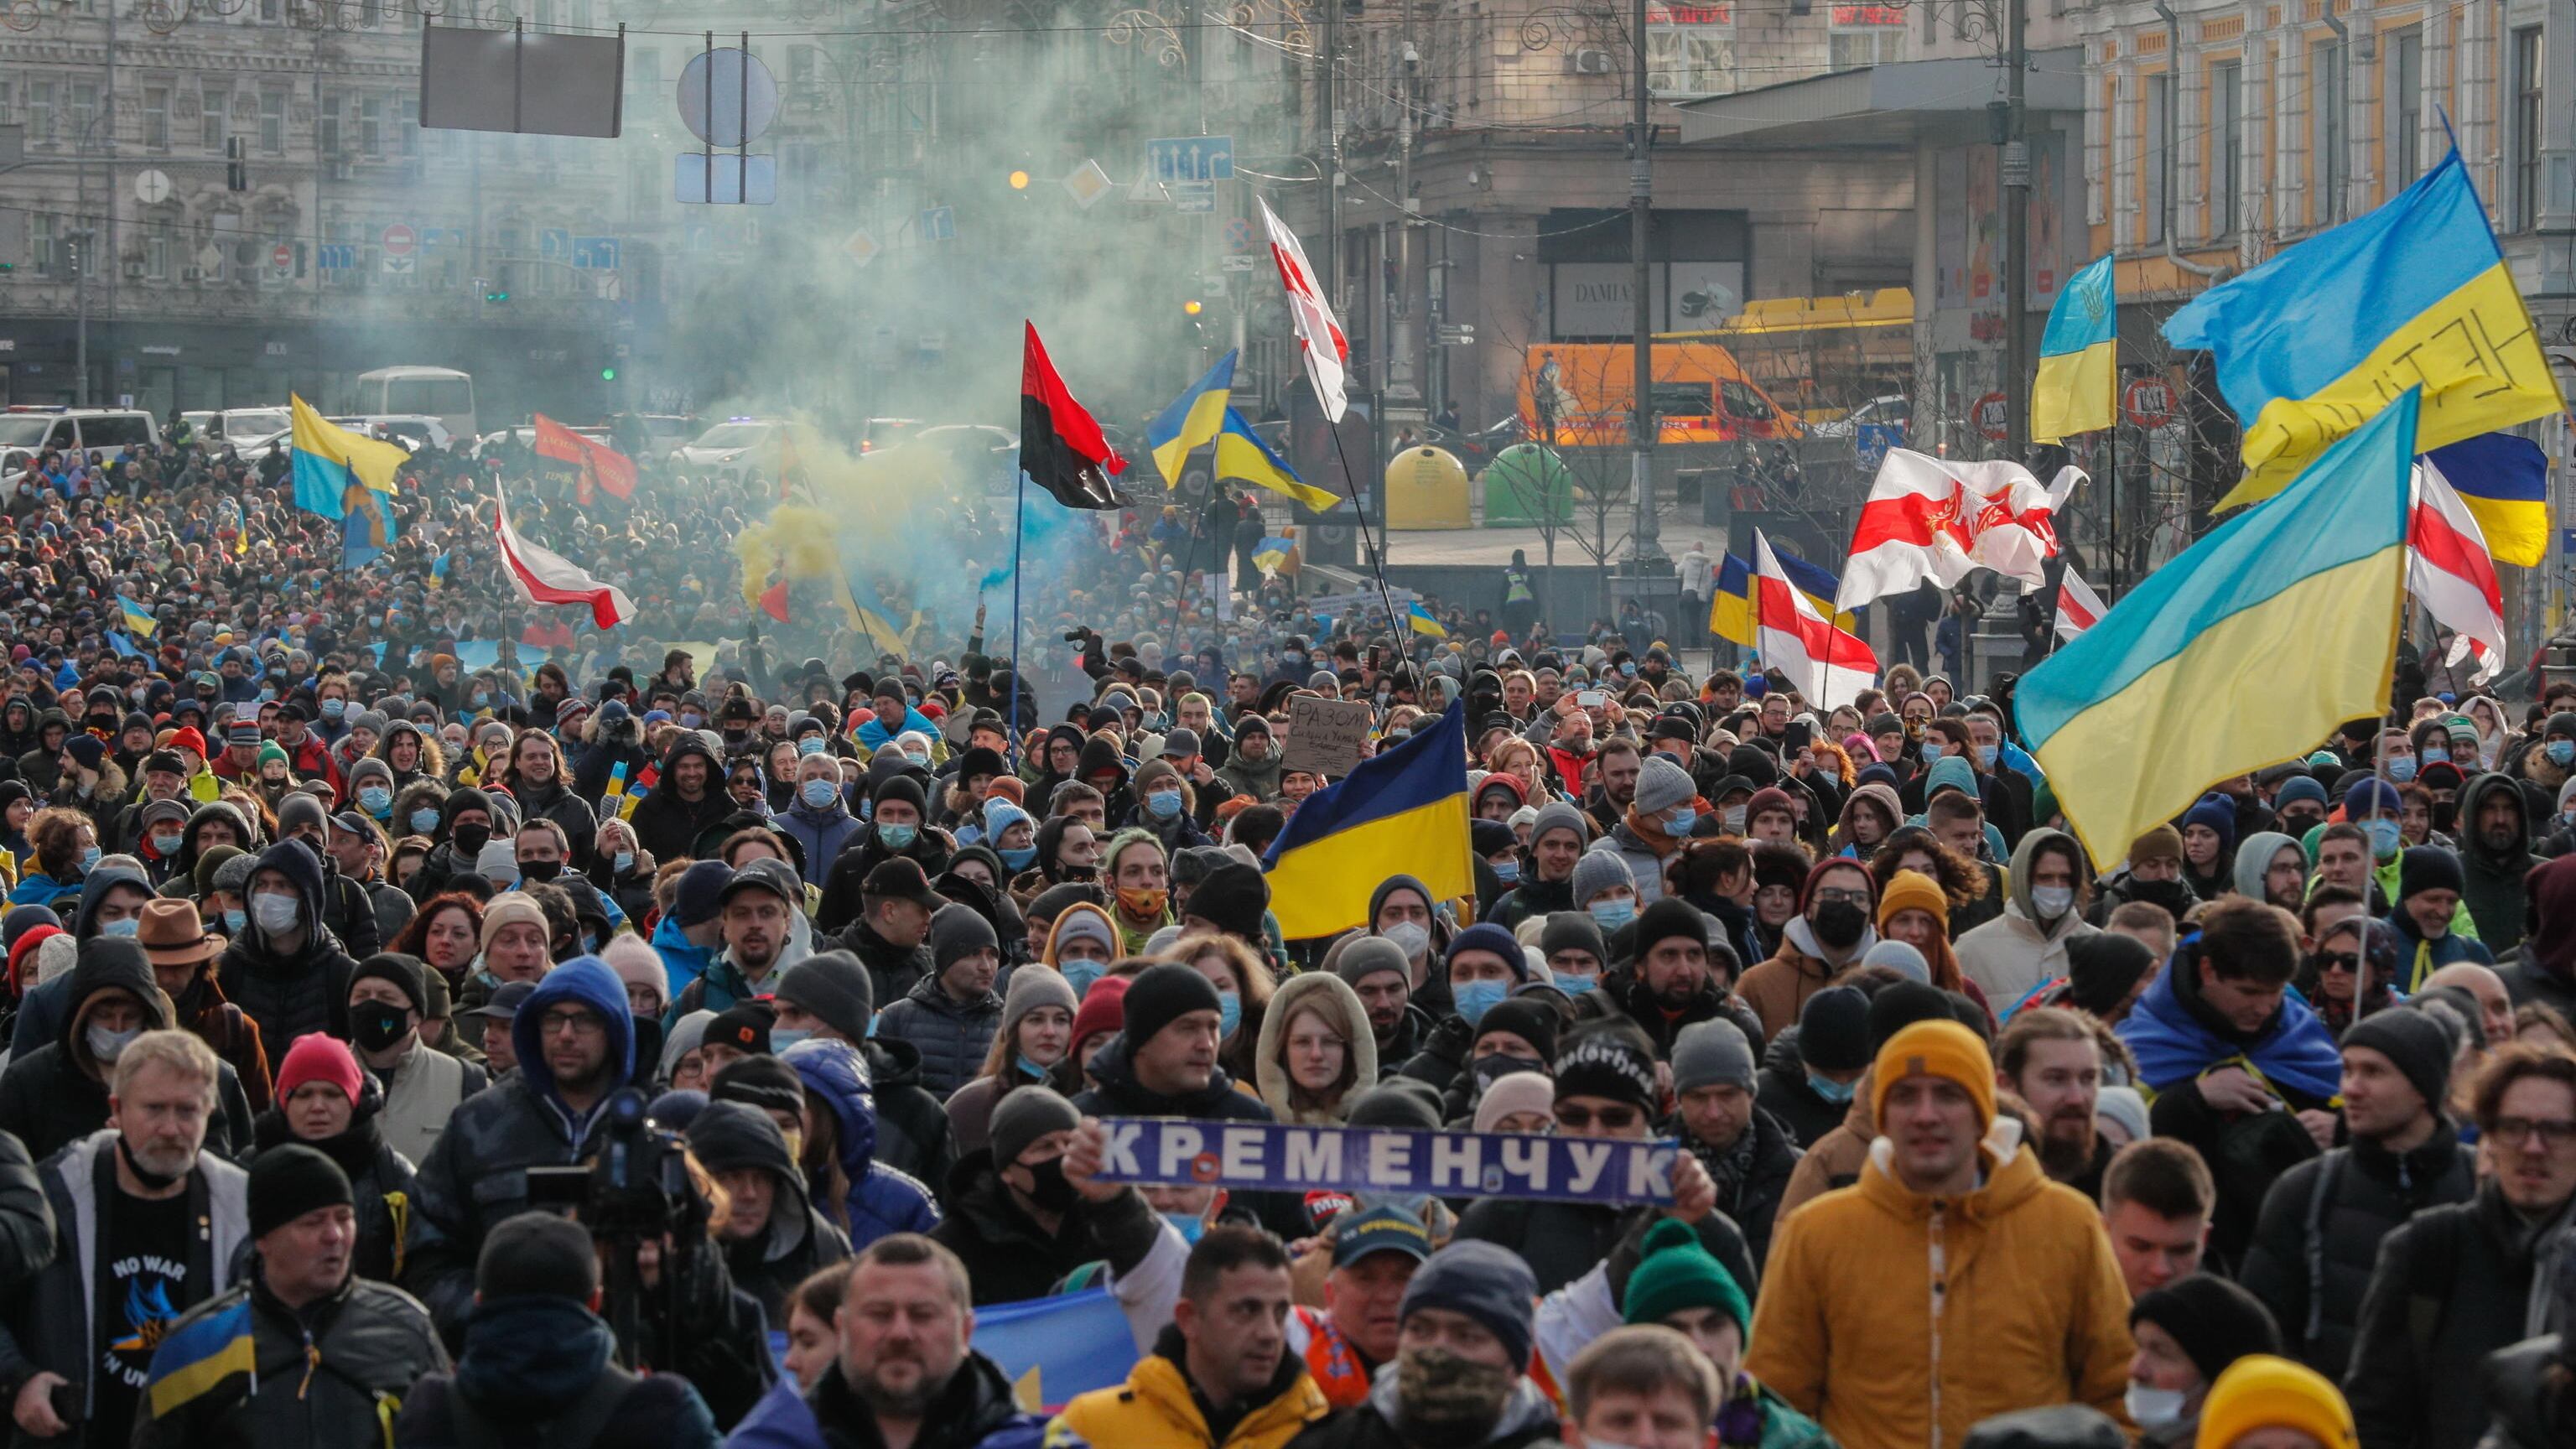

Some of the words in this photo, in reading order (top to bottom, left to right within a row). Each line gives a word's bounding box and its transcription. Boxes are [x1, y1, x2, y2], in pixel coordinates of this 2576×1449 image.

[1576, 283, 1634, 303] DAMIA
[1296, 702, 1365, 727] РАЗОМ
[1099, 1120, 1675, 1199] КРЕМЕНЧУК
[112, 1257, 141, 1279] NO
[143, 1255, 187, 1282] WAR
